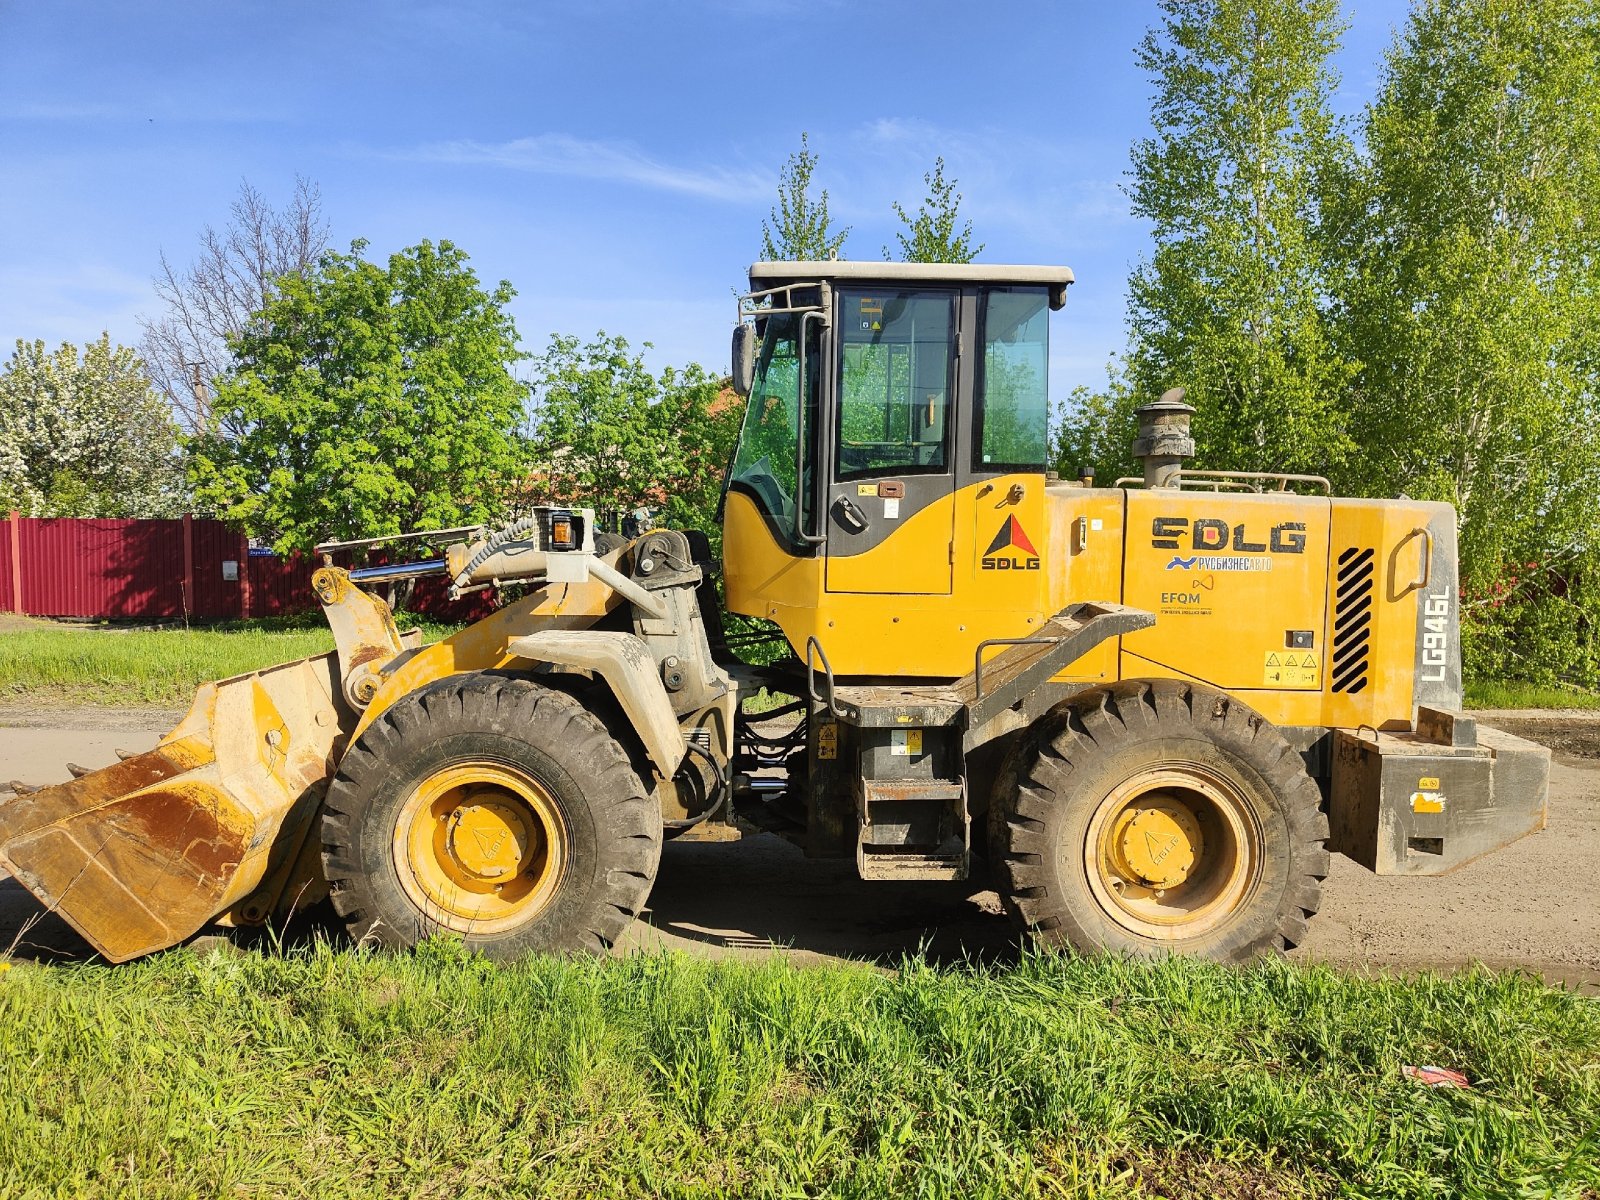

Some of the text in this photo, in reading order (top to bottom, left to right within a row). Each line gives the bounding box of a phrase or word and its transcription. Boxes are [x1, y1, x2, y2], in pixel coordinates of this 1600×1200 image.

[1152, 517, 1306, 554] SDLG
[982, 558, 1040, 570] SDLG
[1198, 557, 1272, 571] РУСБИЗНЕСАВТО
[1161, 592, 1200, 604] EFQM
[1421, 585, 1450, 682] LG946L
